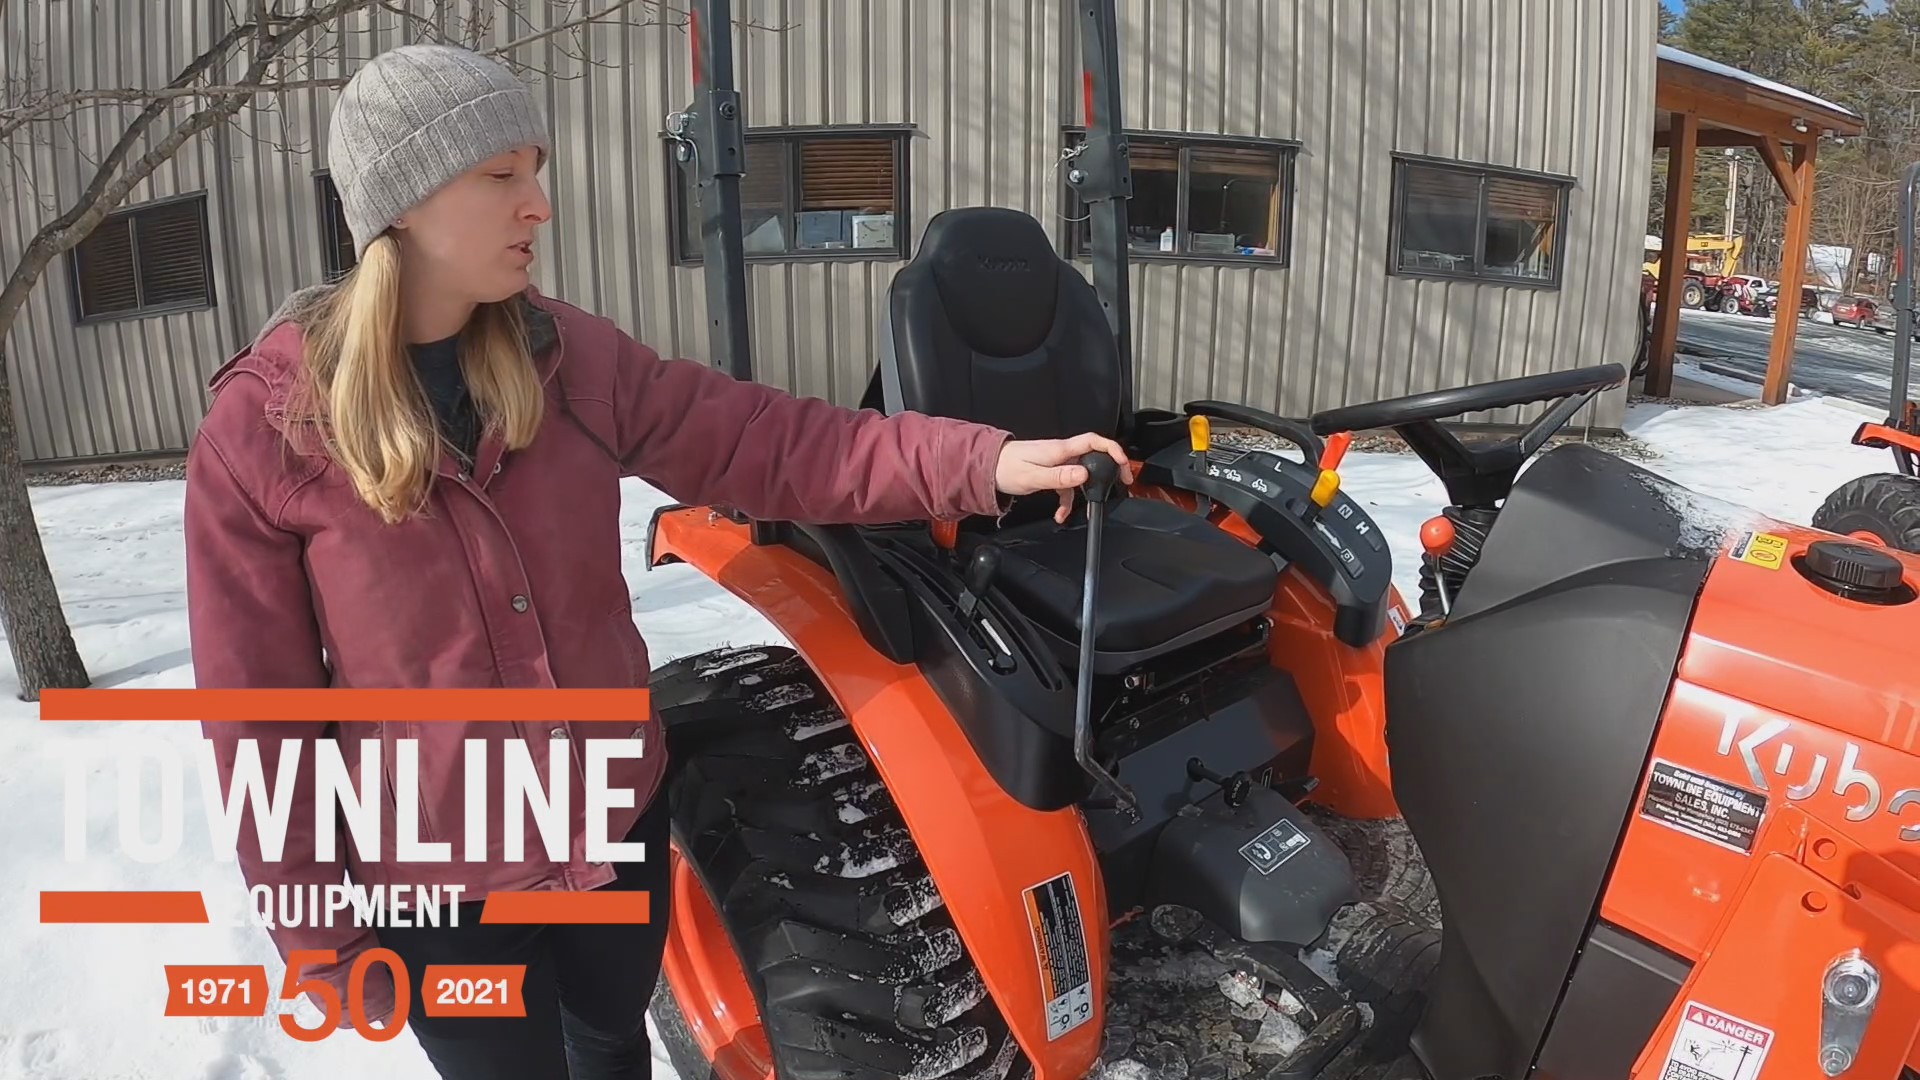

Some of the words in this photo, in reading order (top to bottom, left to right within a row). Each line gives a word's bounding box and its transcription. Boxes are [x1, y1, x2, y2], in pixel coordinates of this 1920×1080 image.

[1273, 461, 1282, 473] L
[1355, 521, 1370, 535] H
[1652, 771, 1704, 798] TOWNLINE
[1703, 788, 1762, 818] EQUIPMENT
[1674, 792, 1709, 814] SALES,
[1710, 803, 1730, 820] INC.
[1705, 1014, 1765, 1045] DANGER
